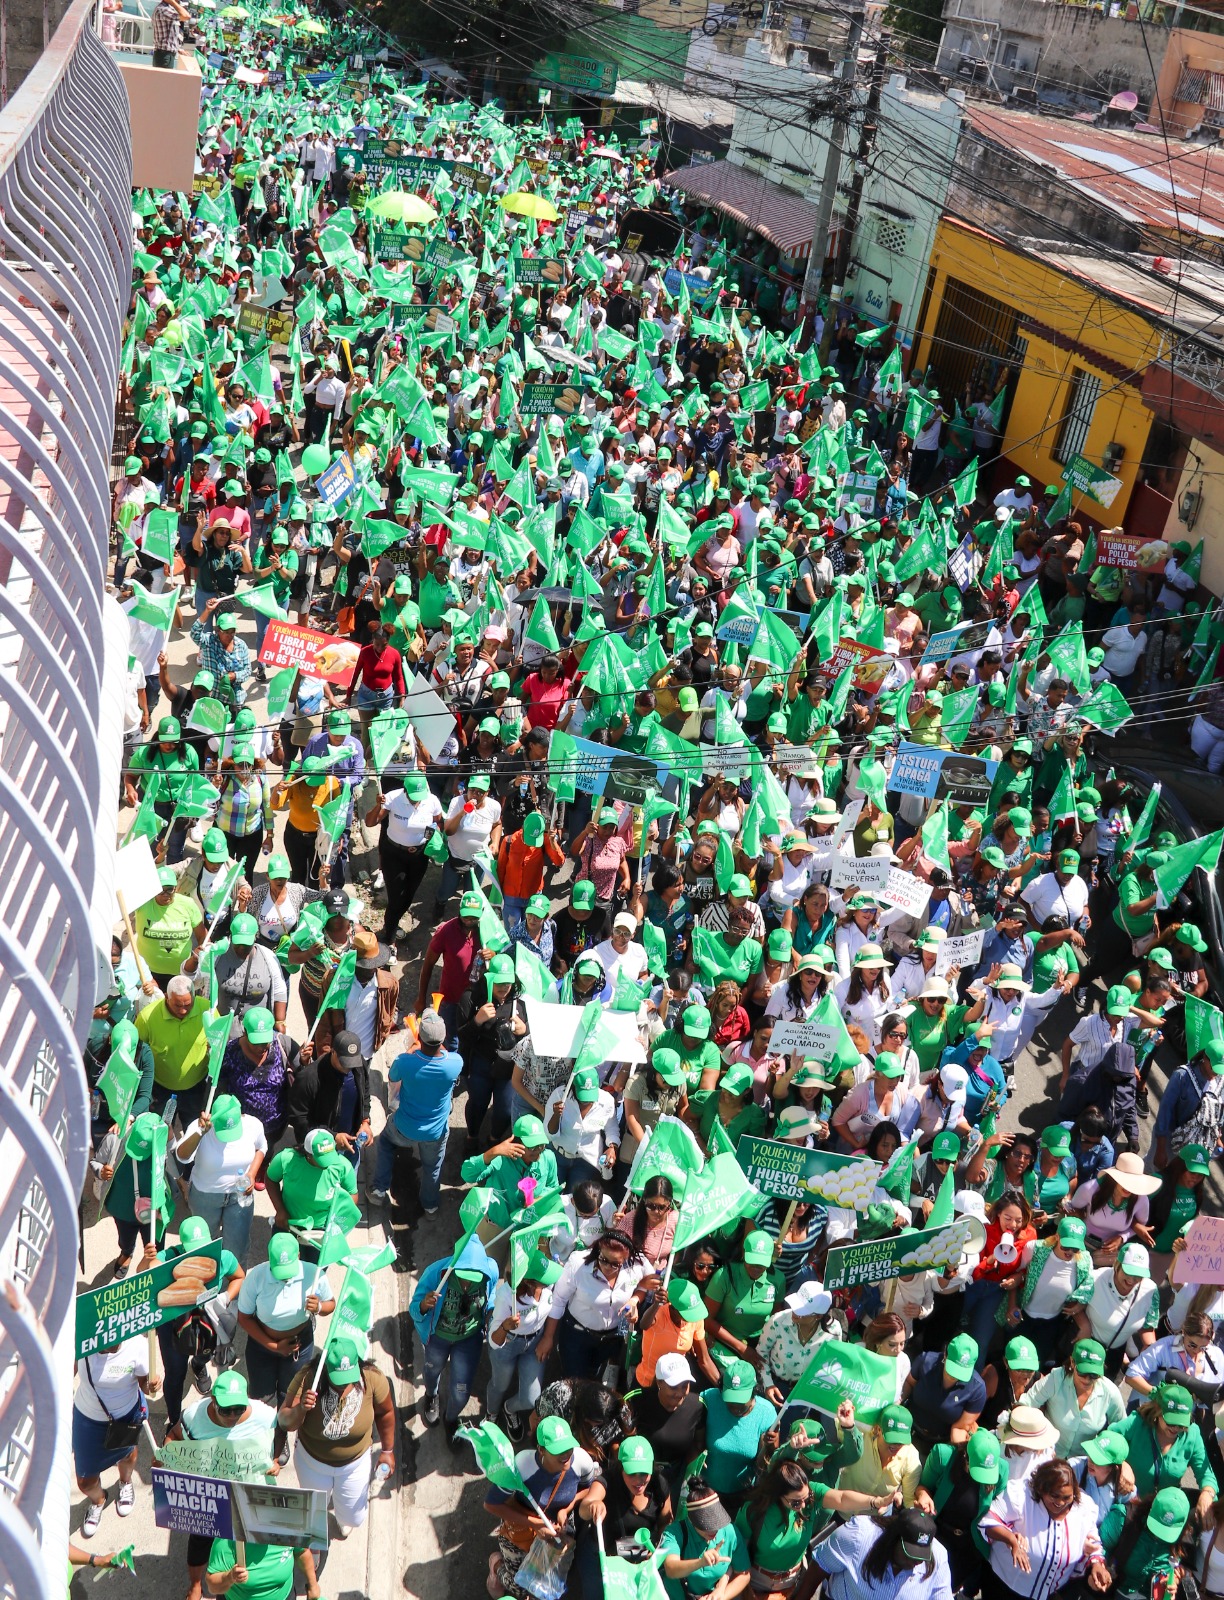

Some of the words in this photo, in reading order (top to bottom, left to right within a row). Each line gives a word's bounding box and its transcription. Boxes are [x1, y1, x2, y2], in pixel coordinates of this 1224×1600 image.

[1108, 542, 1127, 550] LIBRA
[1109, 550, 1128, 559] POLLO
[1117, 558, 1137, 567] PESOS
[276, 625, 290, 635] QUIÉN
[300, 631, 314, 641] VISTO
[314, 636, 324, 644] ESO
[274, 633, 278, 641] 1
[279, 634, 304, 649] LIBRA
[306, 642, 318, 653] DE
[263, 650, 274, 660] EN
[276, 654, 287, 664] 85
[279, 644, 306, 659] POLLO
[902, 754, 939, 771] ESTUFA
[844, 875, 880, 883] REVERSA
[892, 872, 905, 882] LEY
[684, 883, 713, 893] NEVER
[885, 891, 910, 907] CARO
[145, 930, 163, 938] NEW
[952, 935, 980, 948] SABEN
[785, 1029, 831, 1039] AGUANTAMOS
[781, 1039, 825, 1050] COLMADO
[752, 1143, 758, 1152] Y
[760, 1144, 790, 1159] QUIÉN
[792, 1152, 806, 1163] HA
[752, 1155, 779, 1169] VISTO
[782, 1161, 801, 1173] ESO
[746, 1166, 753, 1176] 1
[756, 1166, 798, 1185] HUEVO
[764, 1180, 805, 1198] PESOS
[696, 1202, 713, 1216] DEL
[842, 1251, 848, 1260] Y
[849, 1245, 879, 1258] QUIÉN
[882, 1241, 897, 1250] HA
[844, 1256, 870, 1267] VISTO
[873, 1251, 892, 1261] ESO
[840, 1268, 844, 1277] 1
[848, 1260, 892, 1275] HUEVO
[829, 1279, 844, 1289] EN
[848, 1276, 855, 1285] 8
[859, 1266, 900, 1284] PESOS
[94, 1291, 102, 1305] Y
[104, 1280, 135, 1303] QUIÉN
[138, 1274, 153, 1289] HA
[97, 1297, 130, 1319] VISTO
[130, 1290, 150, 1308] ESO
[96, 1320, 103, 1334] 2
[108, 1302, 151, 1329] PANES
[81, 1338, 98, 1354] EN
[103, 1330, 118, 1346] 15
[121, 1308, 162, 1339] PESOS
[808, 1377, 836, 1391] FP
[840, 1390, 856, 1401] DEL
[857, 1394, 889, 1408] PUEBLO
[846, 1379, 871, 1395] FUERZA
[154, 1475, 164, 1483] LA
[164, 1475, 229, 1500] NEVERA
[166, 1490, 219, 1513] VACÍA
[171, 1507, 194, 1517] ESTUFA
[177, 1522, 189, 1530] HAY
[197, 1520, 215, 1529] MESA
